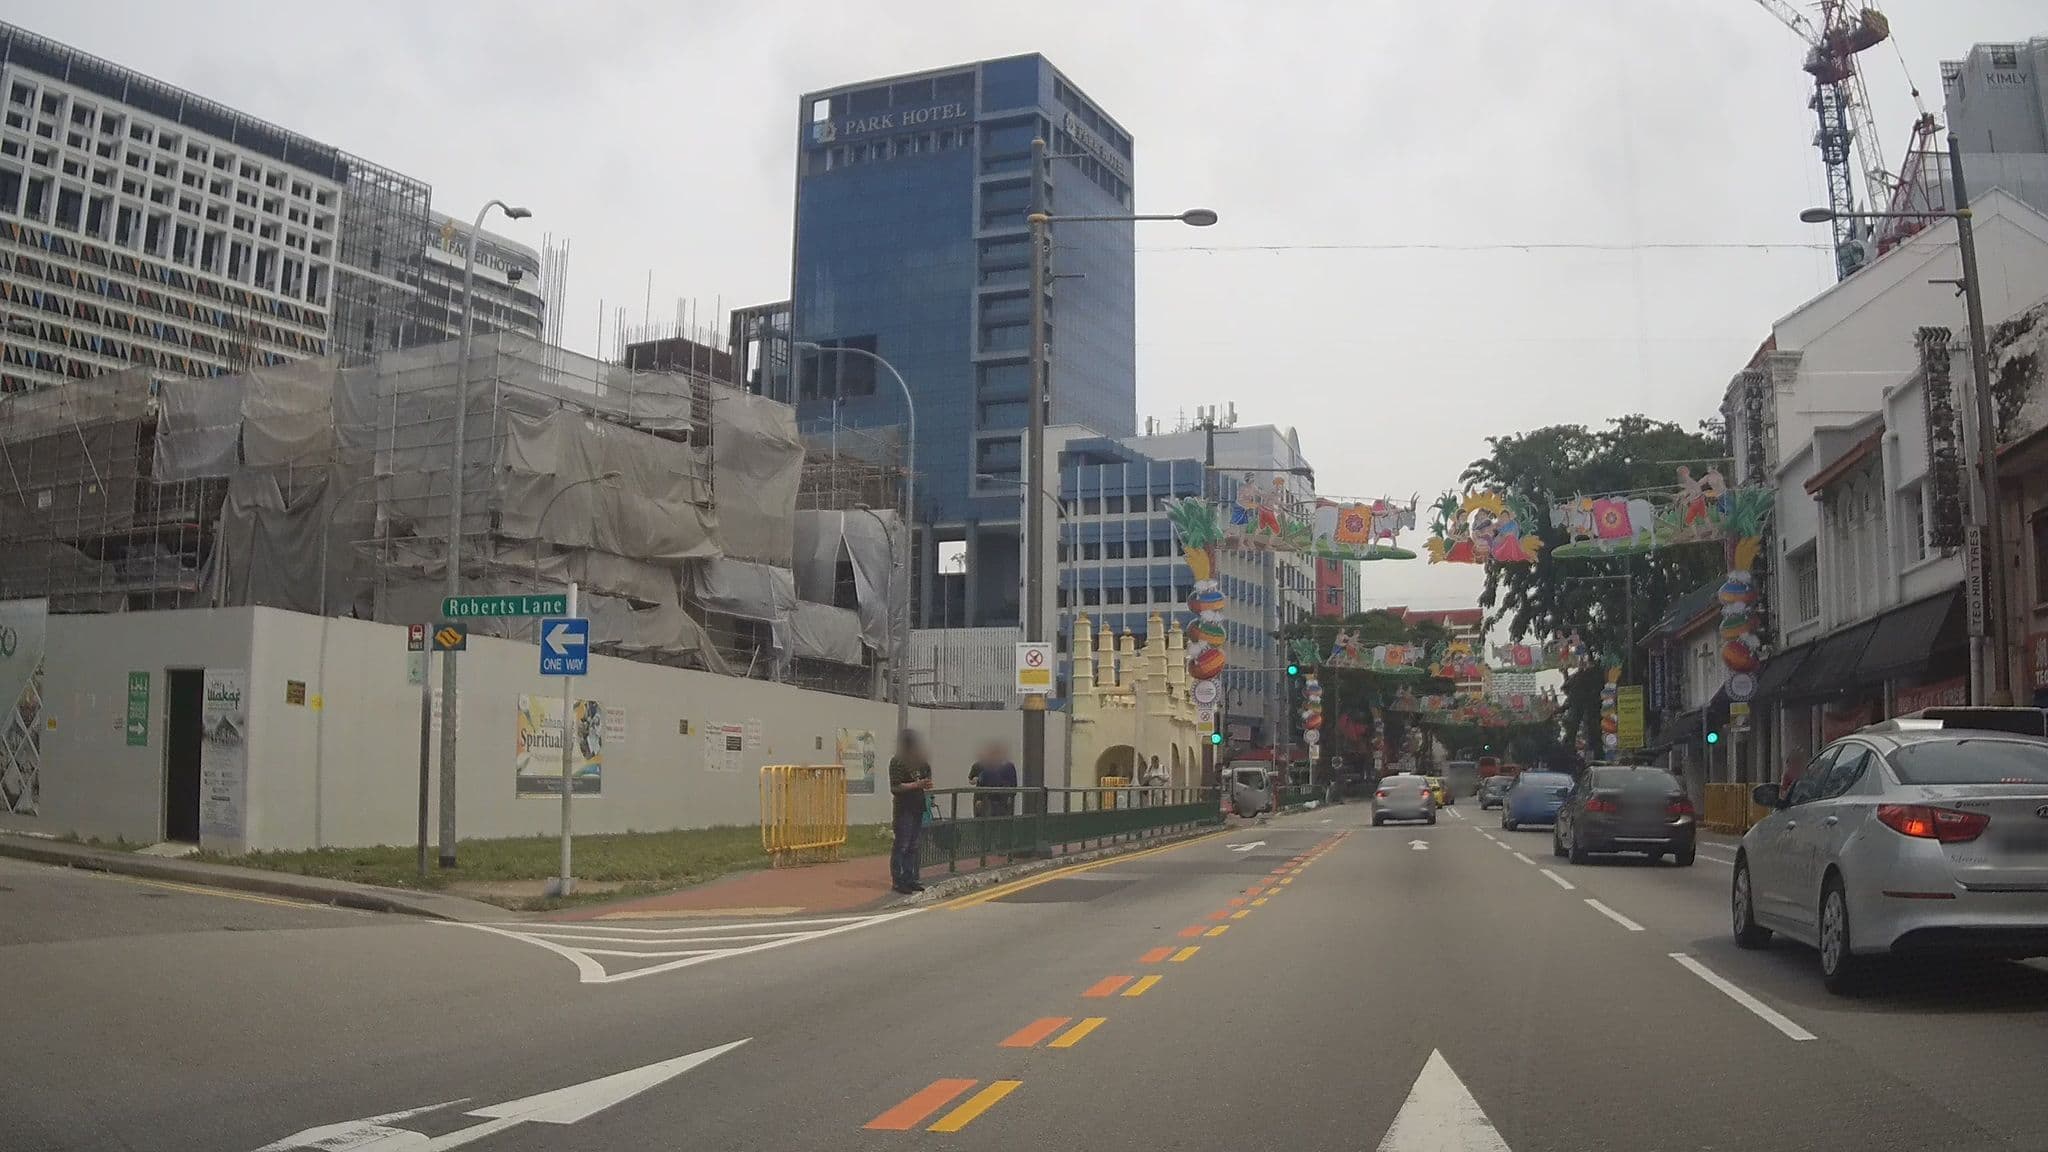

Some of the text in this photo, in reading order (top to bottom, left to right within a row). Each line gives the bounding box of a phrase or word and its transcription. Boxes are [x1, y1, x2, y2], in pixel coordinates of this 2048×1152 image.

[1986, 72, 2028, 84] KIMLY
[845, 103, 967, 135] PARK HOTEL
[1969, 531, 1980, 572] TYRES
[450, 598, 562, 615] Roberts Lane
[1972, 600, 1981, 625] TEO
[543, 658, 584, 671] ONE WAY
